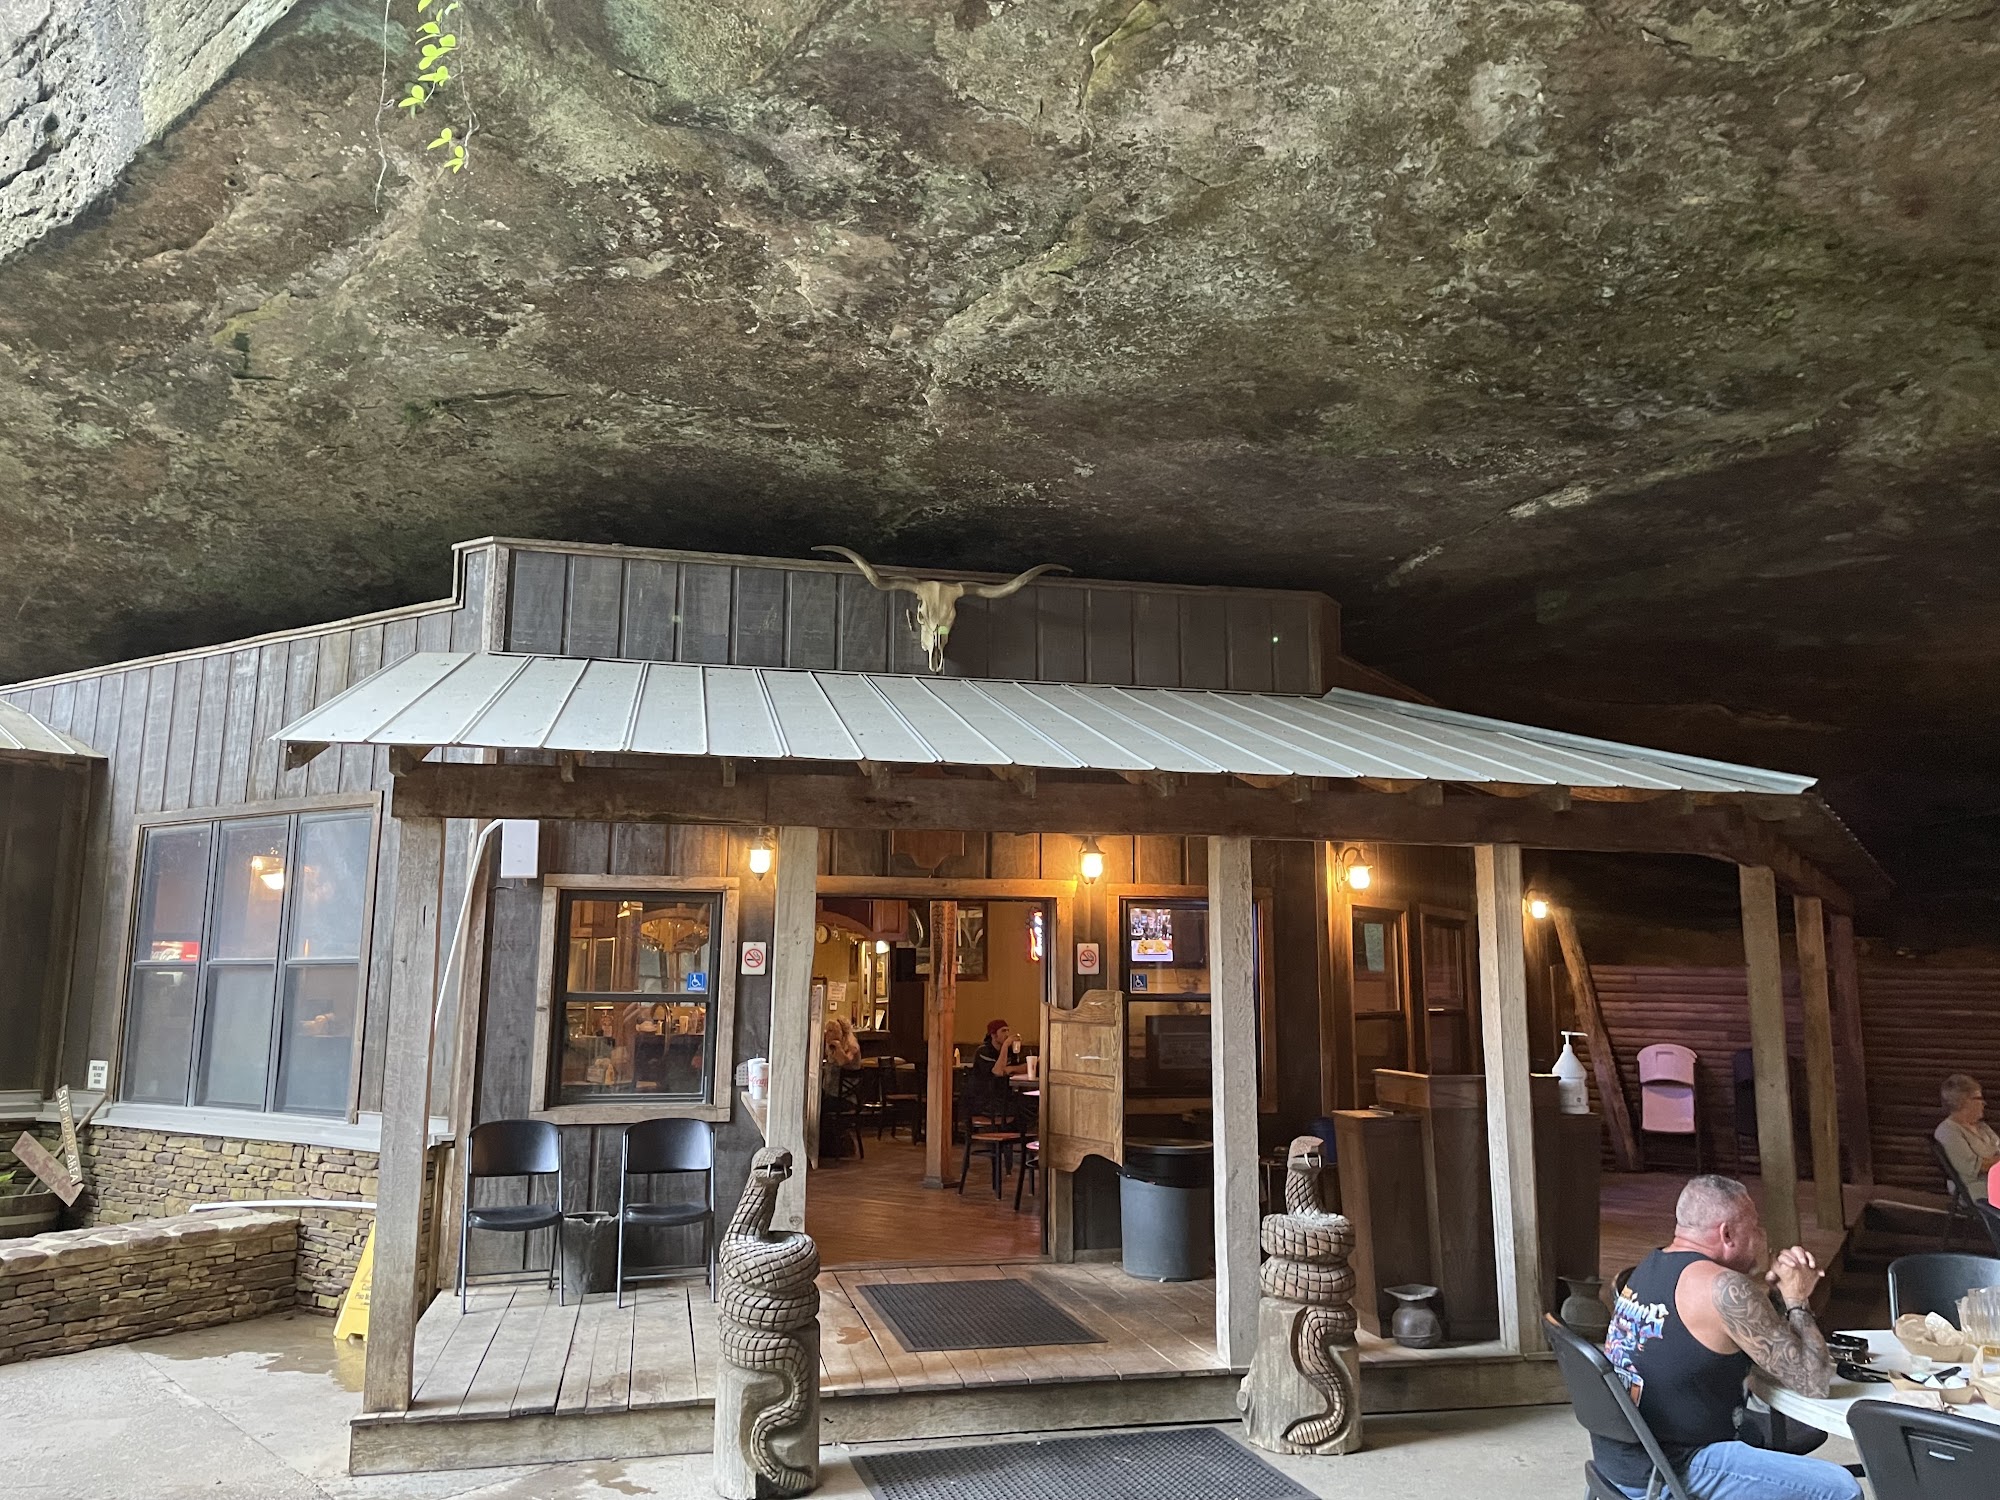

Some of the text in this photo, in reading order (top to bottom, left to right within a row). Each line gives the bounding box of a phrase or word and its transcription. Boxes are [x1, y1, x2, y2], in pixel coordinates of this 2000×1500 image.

[58, 1089, 79, 1183] SLIP HAZARD AREA
